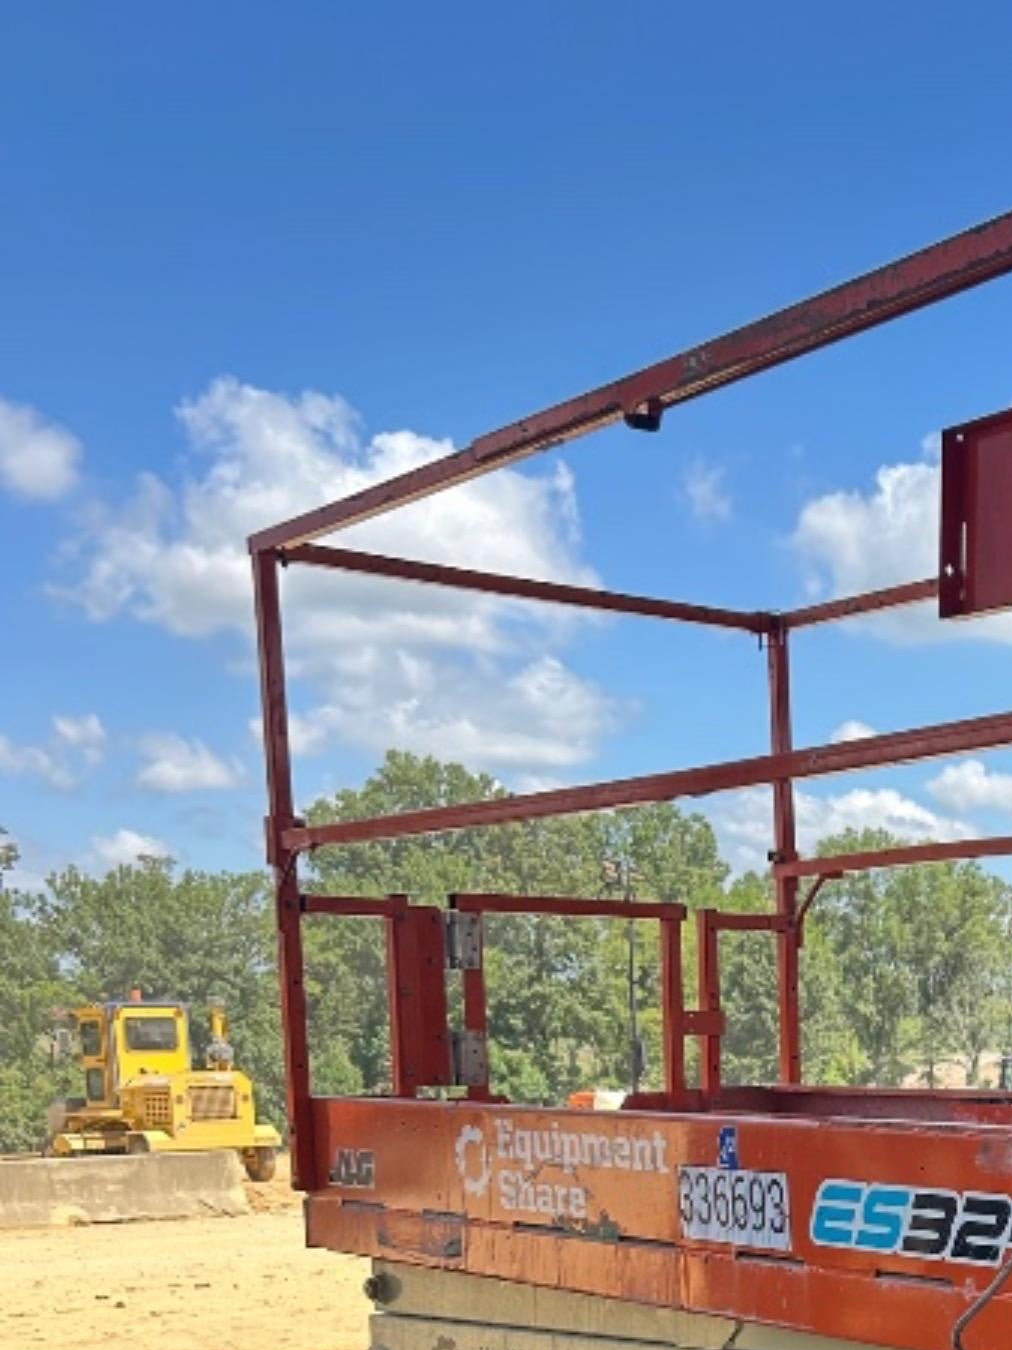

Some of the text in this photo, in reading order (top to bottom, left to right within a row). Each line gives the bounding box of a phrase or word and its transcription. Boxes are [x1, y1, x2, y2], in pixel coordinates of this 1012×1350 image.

[495, 1117, 669, 1175] Equipment
[499, 1170, 588, 1217] Share
[680, 1170, 785, 1233] 336693
